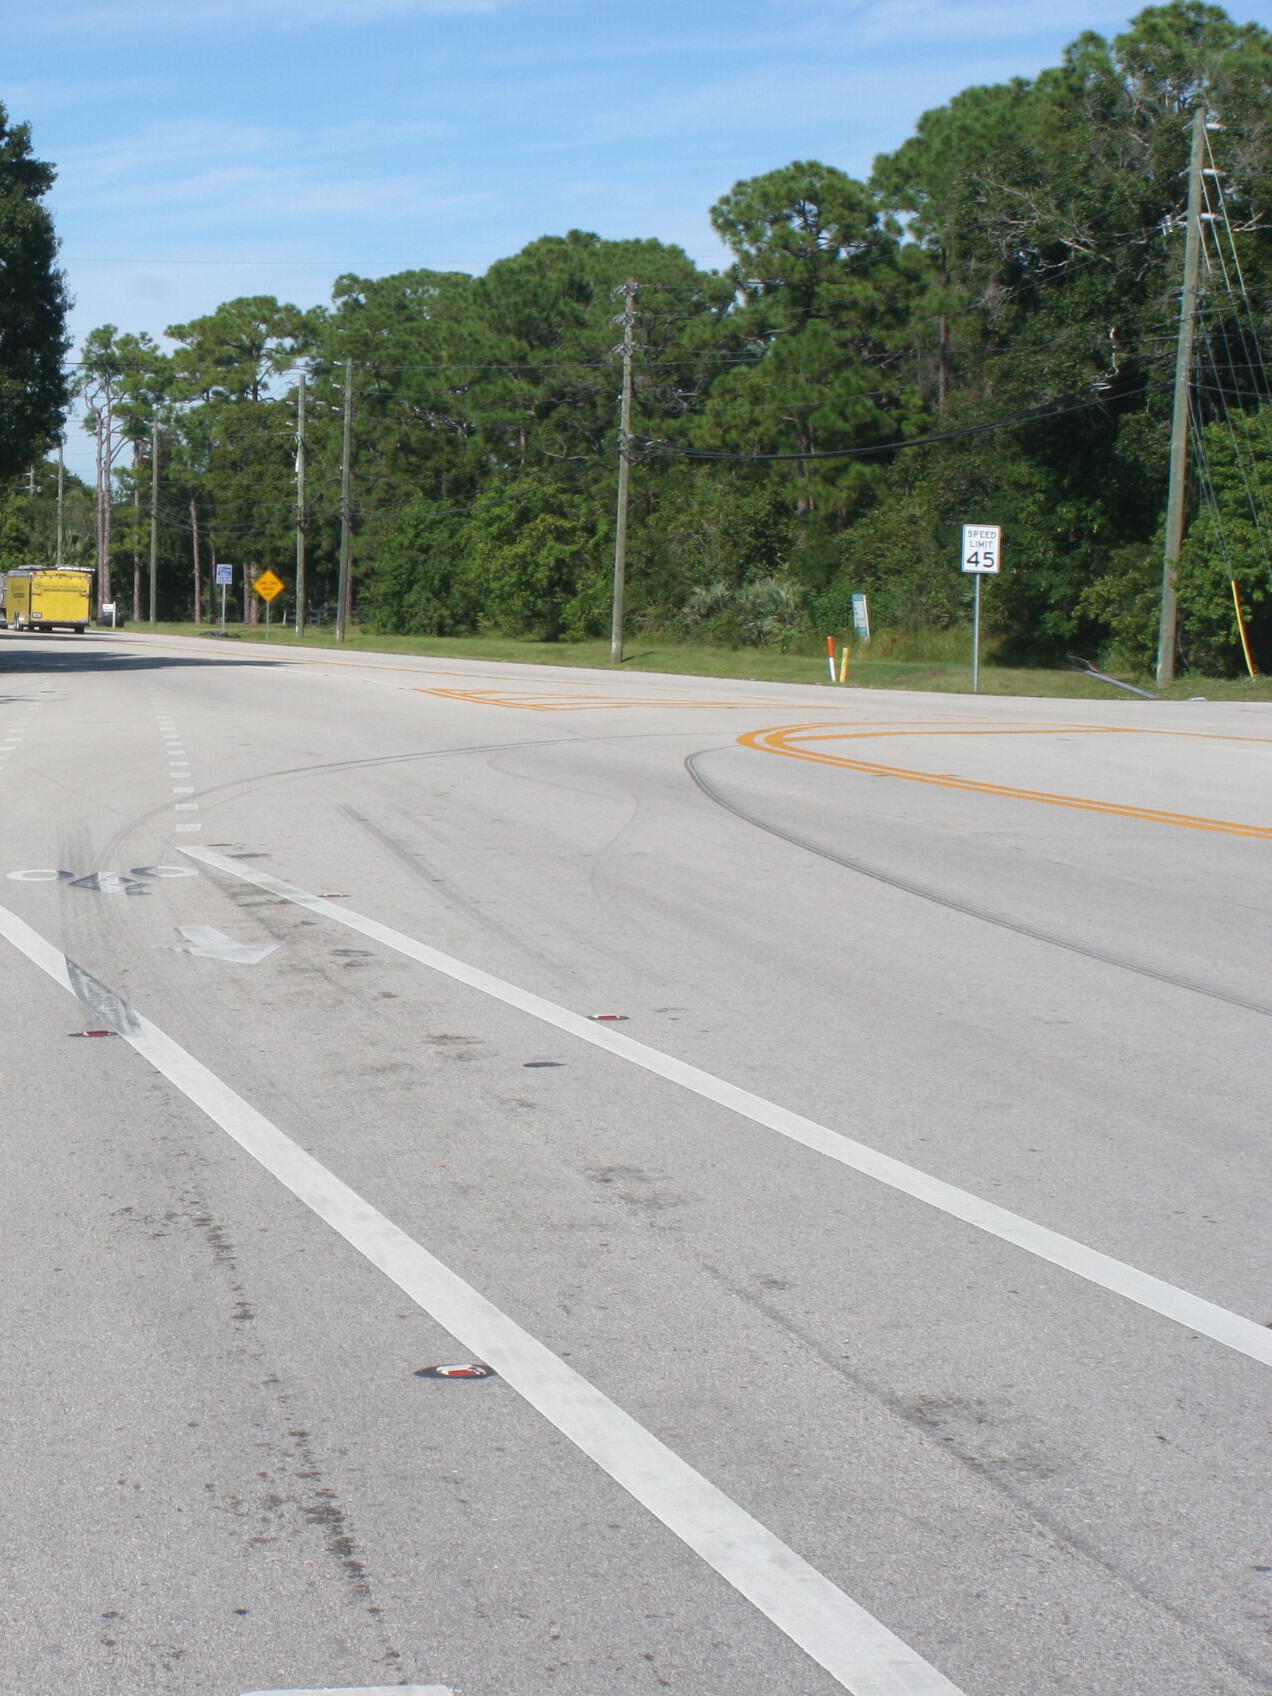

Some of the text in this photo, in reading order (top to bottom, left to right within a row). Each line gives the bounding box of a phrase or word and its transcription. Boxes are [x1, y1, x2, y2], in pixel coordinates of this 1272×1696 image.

[968, 530, 996, 539] SPEED
[970, 540, 993, 548] LIMIT
[966, 551, 995, 568] 45
